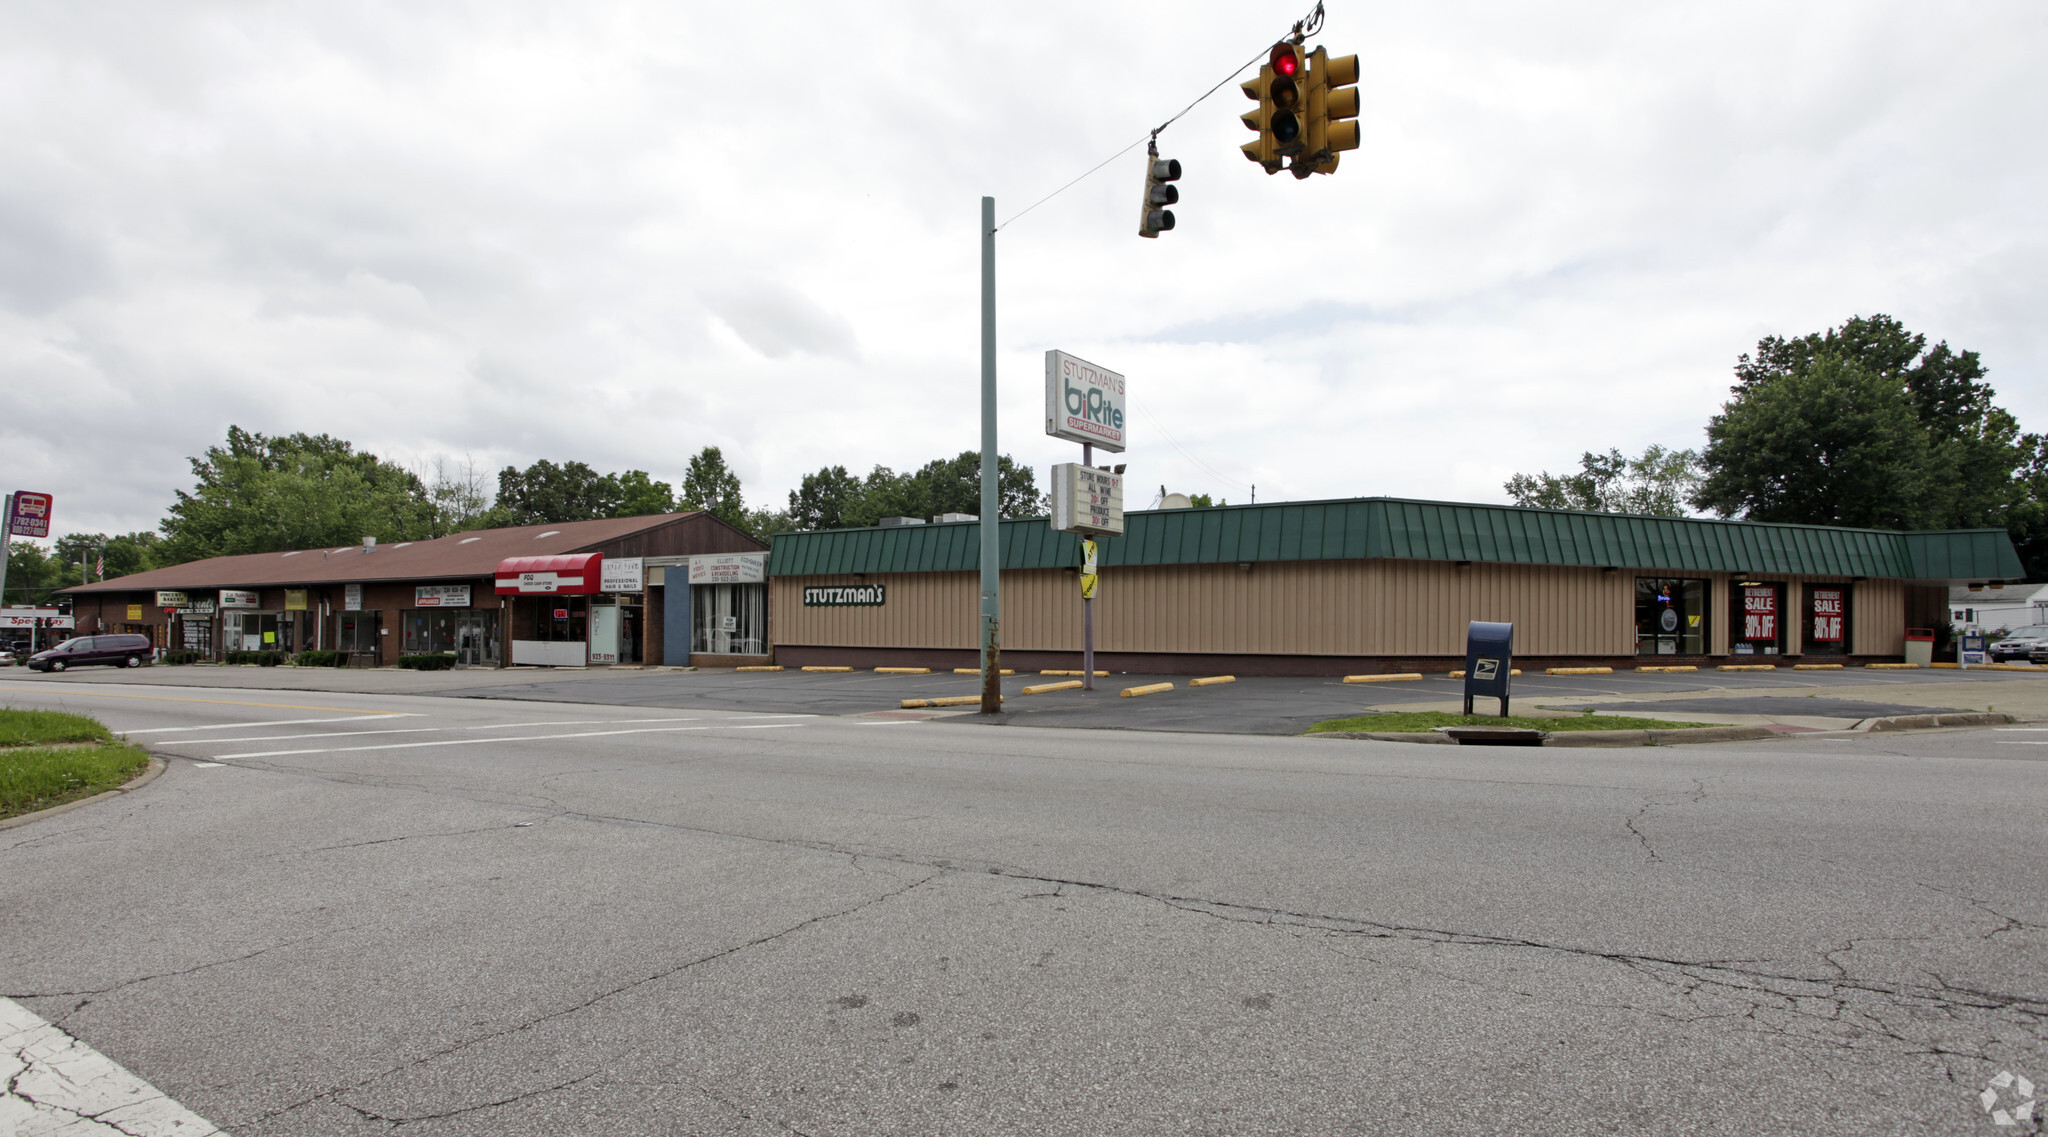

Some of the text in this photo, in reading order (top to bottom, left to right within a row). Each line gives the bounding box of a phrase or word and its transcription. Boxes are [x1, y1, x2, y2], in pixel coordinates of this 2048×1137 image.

[1063, 359, 1124, 395] STUTZMAN'S
[1069, 417, 1121, 441] SUPERMARKET
[1080, 471, 1095, 482] STORE
[1096, 474, 1110, 486] HOURS
[1088, 483, 1112, 497] ALL WINE
[1100, 496, 1109, 506] OFF
[1090, 504, 1110, 517] PRODUCE
[1101, 517, 1110, 527] OFF
[804, 583, 883, 604] STUTZMAN'S
[1744, 587, 1774, 597] RETIREMENT
[1814, 590, 1841, 600] RETIREMENT
[1744, 597, 1774, 610] SALE
[1814, 599, 1841, 613] SALE
[1745, 614, 1774, 638] 30% OFF
[1814, 616, 1842, 639] 30% OFF
